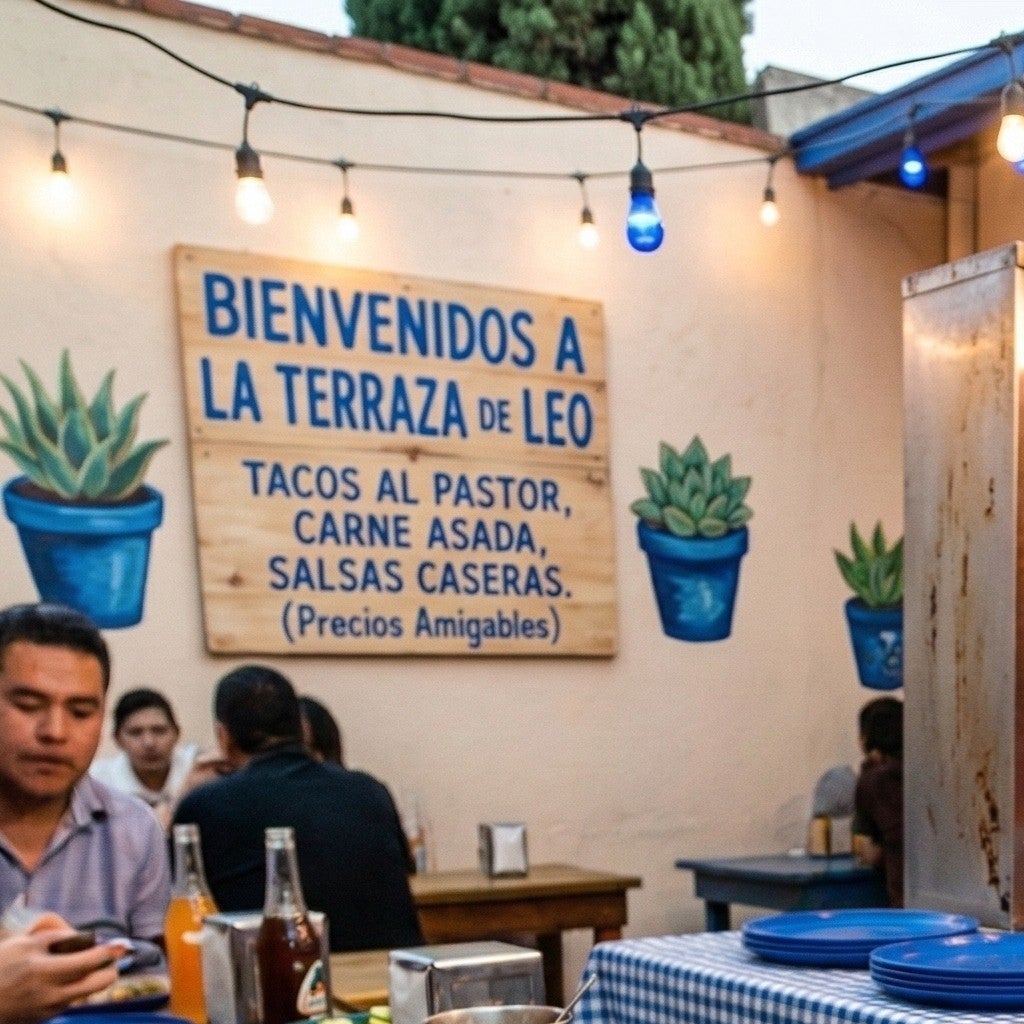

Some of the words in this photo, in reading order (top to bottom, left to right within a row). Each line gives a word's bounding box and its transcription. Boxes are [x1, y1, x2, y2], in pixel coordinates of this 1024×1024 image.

[203, 272, 538, 369] BIENVENIDOS
[555, 316, 586, 375] A
[200, 356, 262, 423] LA
[275, 364, 468, 439] TERRAZA
[479, 398, 511, 433] DE
[522, 388, 593, 449] LEO
[243, 460, 361, 502] TACOS
[376, 469, 419, 505] AL
[433, 473, 572, 519] PASTOR,
[294, 511, 411, 549] CARNE
[427, 517, 547, 559] ASADA,
[268, 556, 404, 593] SALSAS
[417, 561, 572, 598] CASERAS.
[281, 602, 402, 643] (Precios
[414, 606, 561, 649] Amigables)
